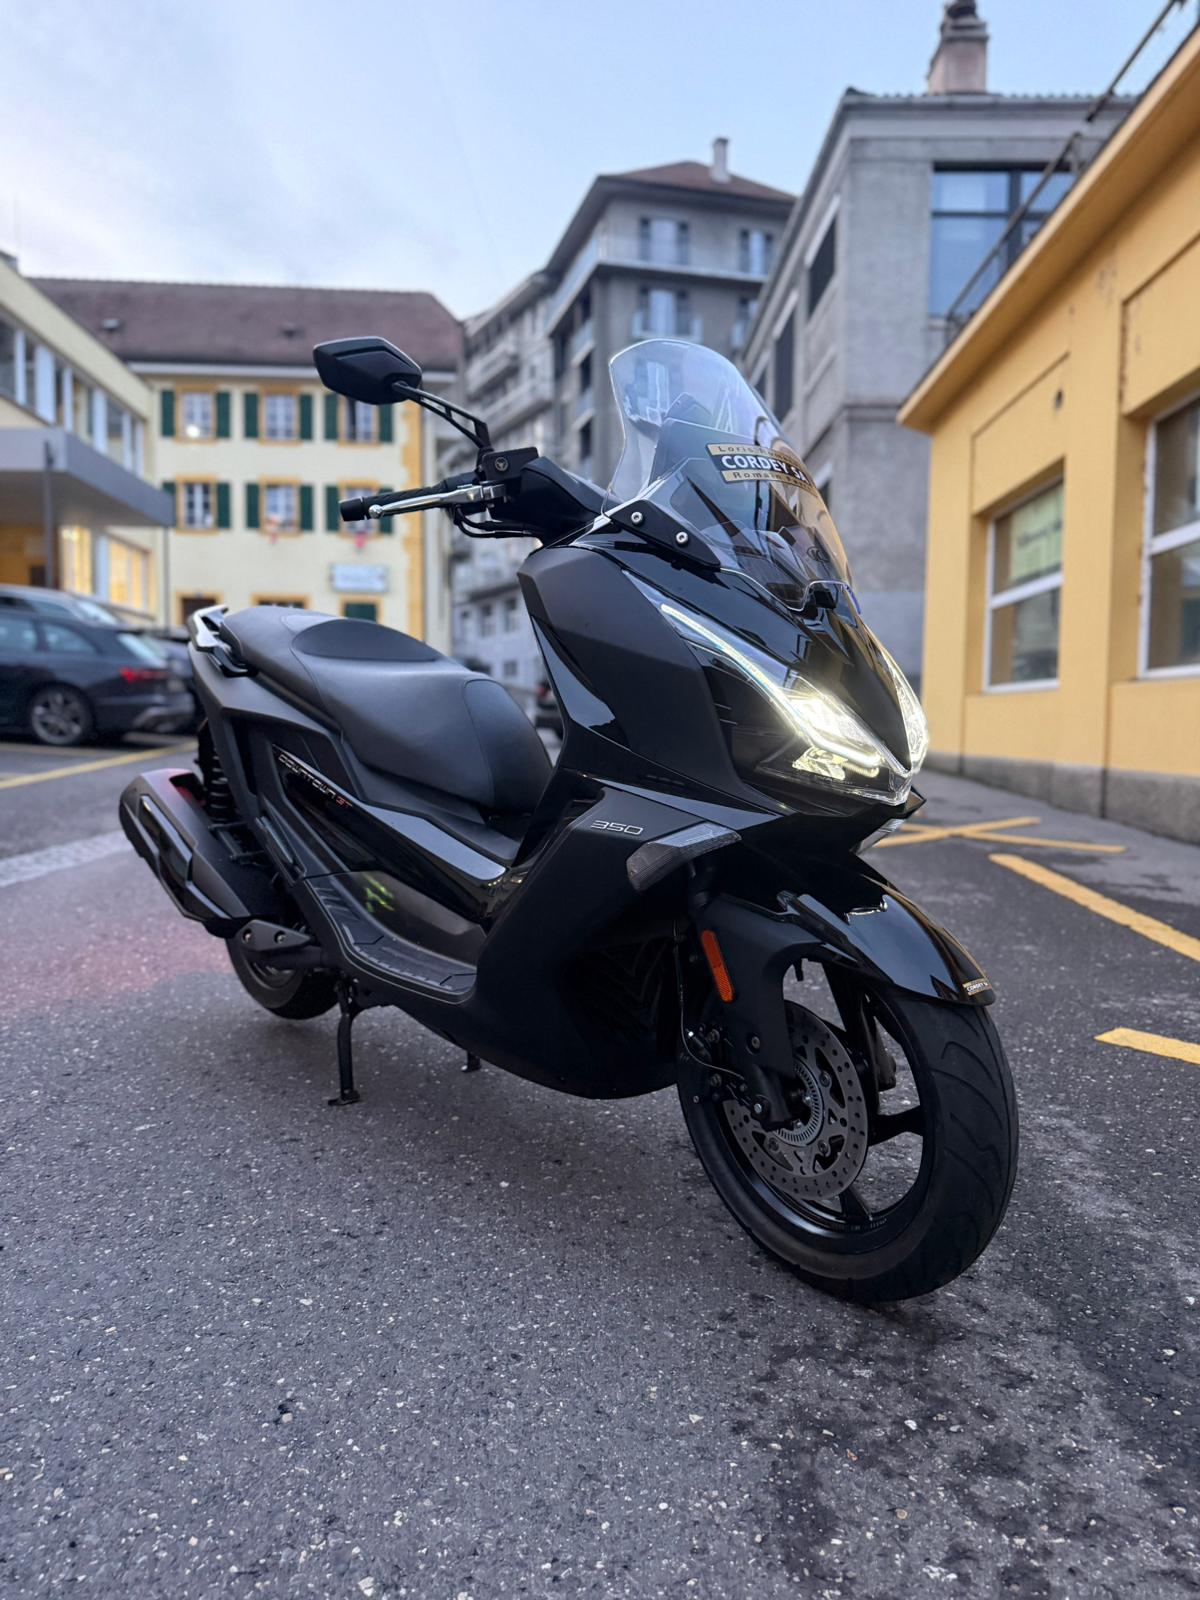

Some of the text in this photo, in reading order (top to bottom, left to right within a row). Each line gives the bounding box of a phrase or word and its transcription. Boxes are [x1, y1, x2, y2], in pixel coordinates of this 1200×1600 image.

[718, 446, 754, 454] Loris
[721, 455, 788, 473] CORDEY
[278, 753, 336, 799] DOWNTOWN
[590, 820, 643, 835] 350
